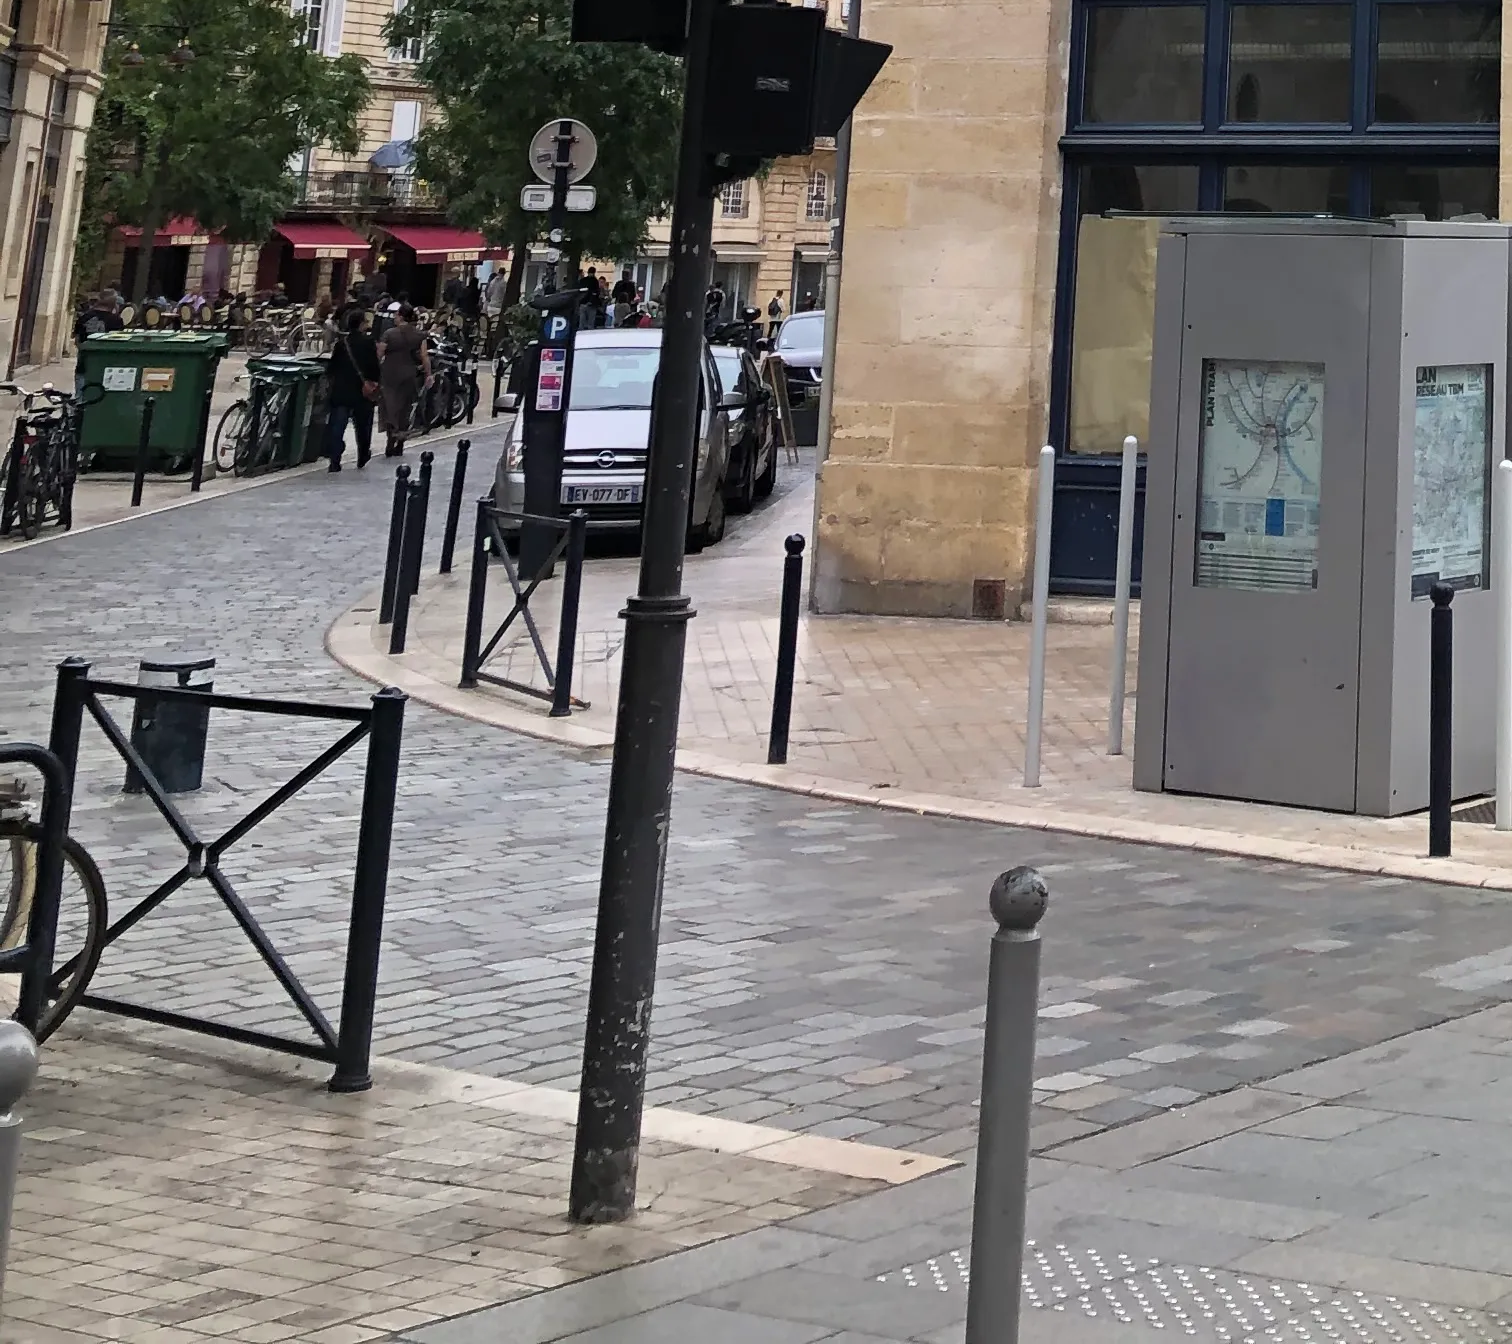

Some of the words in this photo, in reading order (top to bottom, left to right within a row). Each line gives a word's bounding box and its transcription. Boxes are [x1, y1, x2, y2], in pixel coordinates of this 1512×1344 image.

[551, 317, 567, 340] P
[1207, 362, 1217, 394] TRAM
[1206, 397, 1215, 426] PLAN
